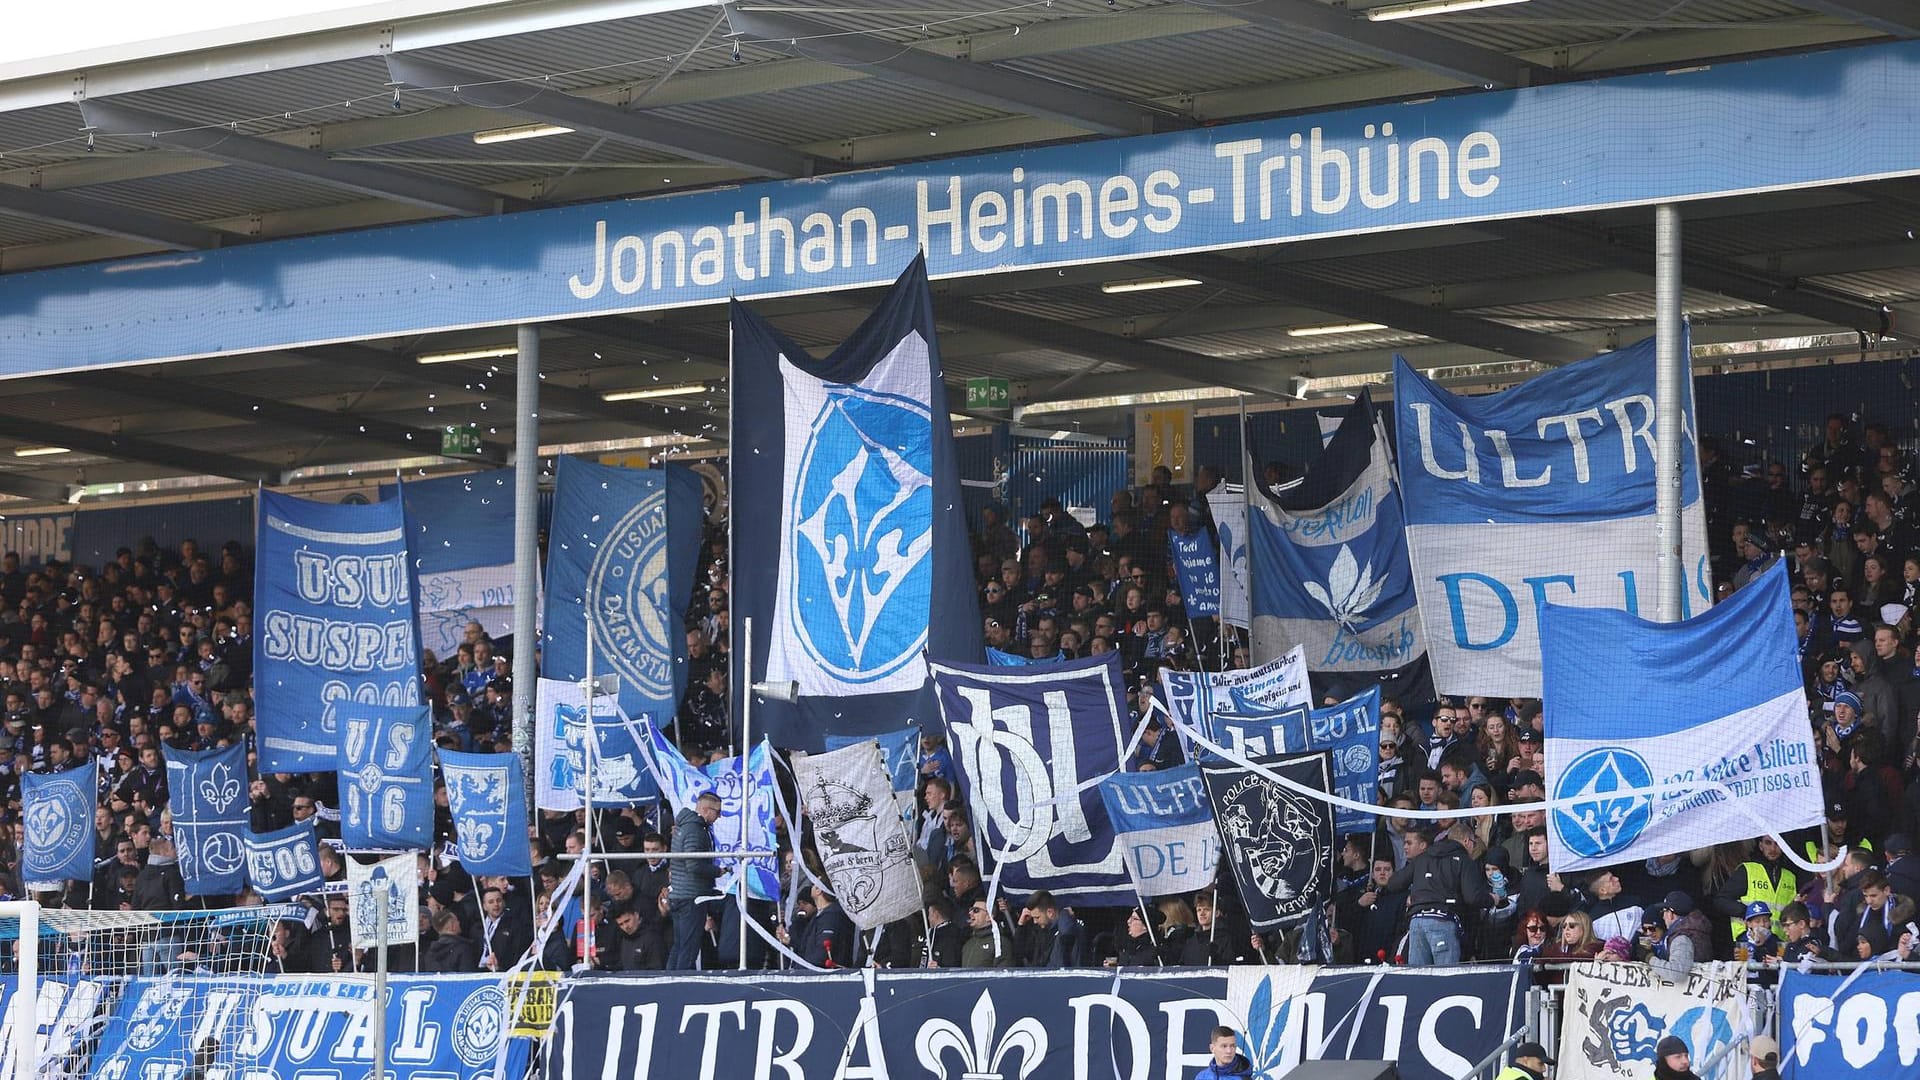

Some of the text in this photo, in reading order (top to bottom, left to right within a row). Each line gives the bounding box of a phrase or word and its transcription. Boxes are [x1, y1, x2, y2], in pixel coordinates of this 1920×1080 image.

[568, 121, 1502, 300] Jonathan-Heimes-Tribüne
[1754, 738, 1809, 770] Lilien
[1222, 773, 1260, 806] POLICE
[1763, 772, 1792, 792] 1898
[63, 823, 82, 851] 1898
[1131, 841, 1189, 880] DE
[1752, 881, 1769, 890] 166
[553, 1000, 893, 1080] ULTRA
